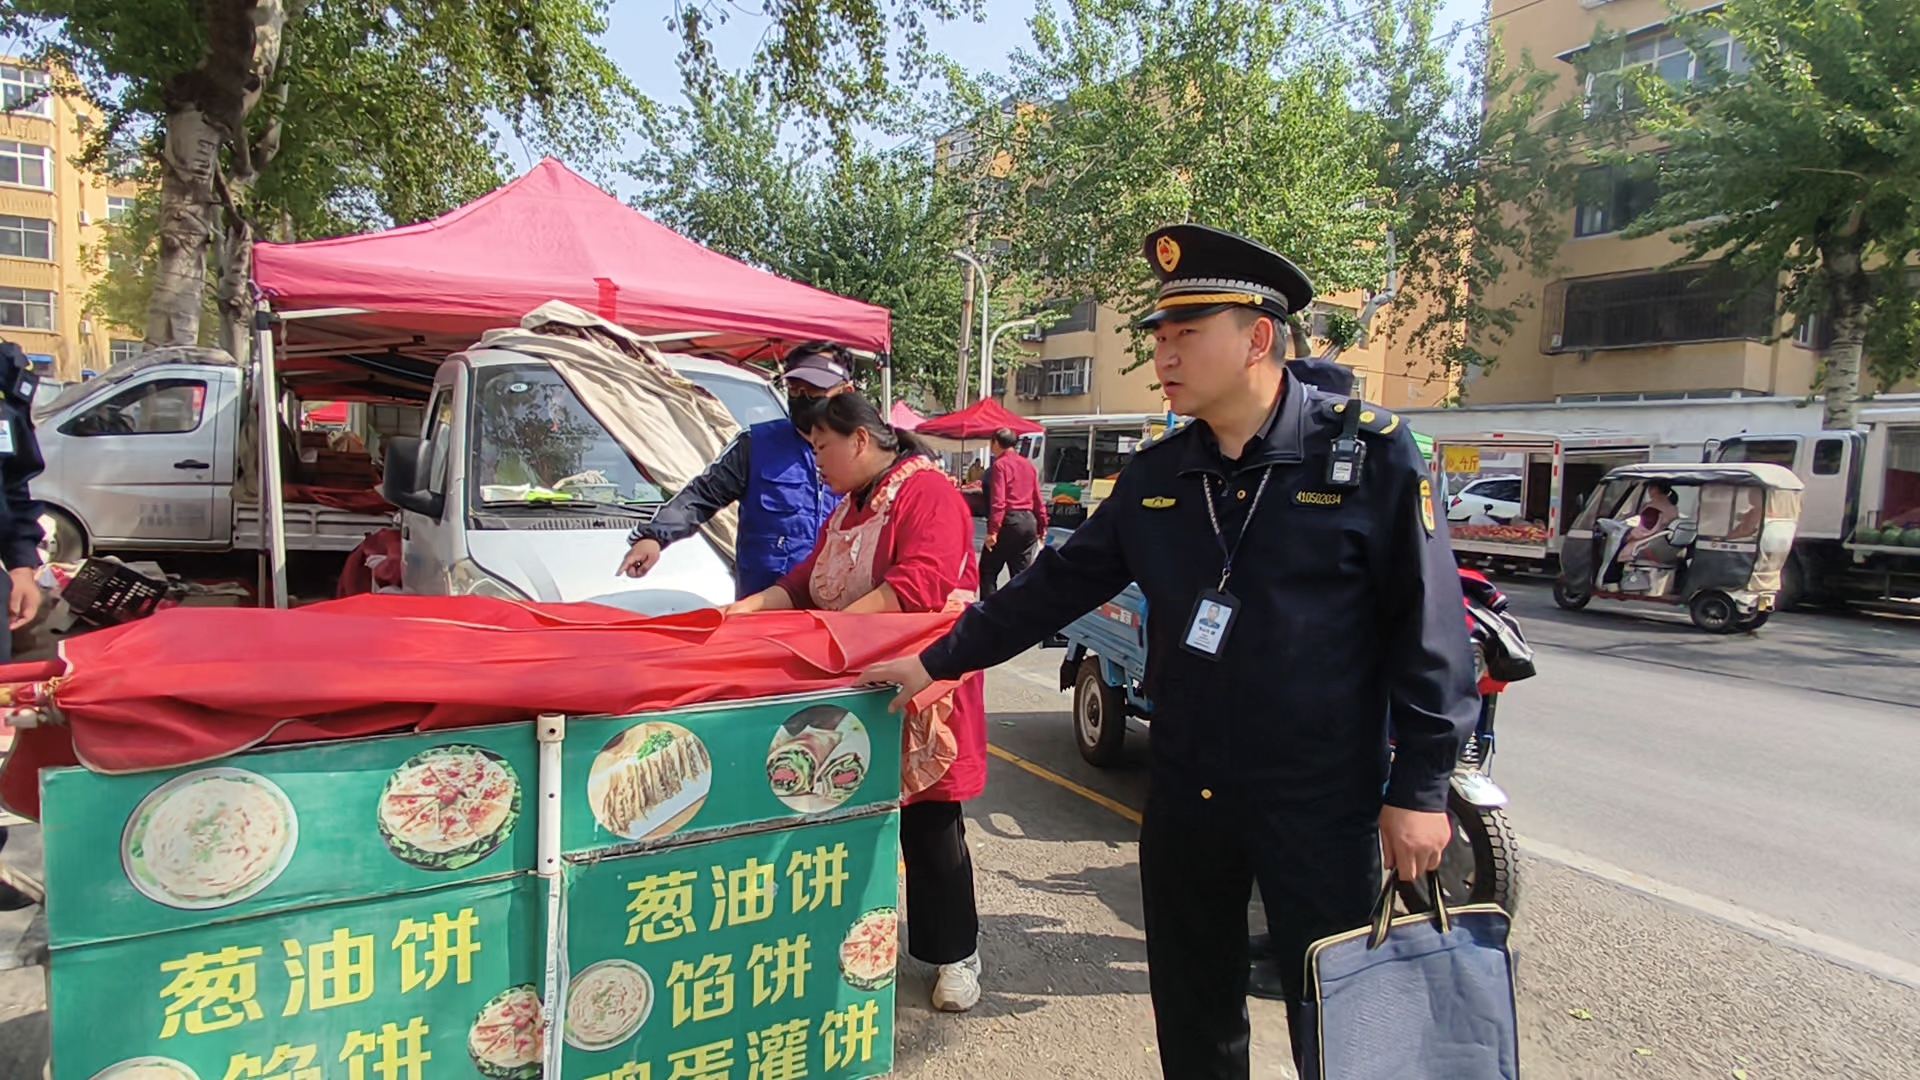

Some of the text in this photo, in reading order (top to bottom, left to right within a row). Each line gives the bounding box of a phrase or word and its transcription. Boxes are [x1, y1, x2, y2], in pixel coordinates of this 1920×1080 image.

[625, 842, 848, 946] 葱油饼
[159, 908, 481, 1039] 葱油饼
[666, 934, 811, 1028] 馅饼
[583, 1000, 879, 1080] 蛋灌饼
